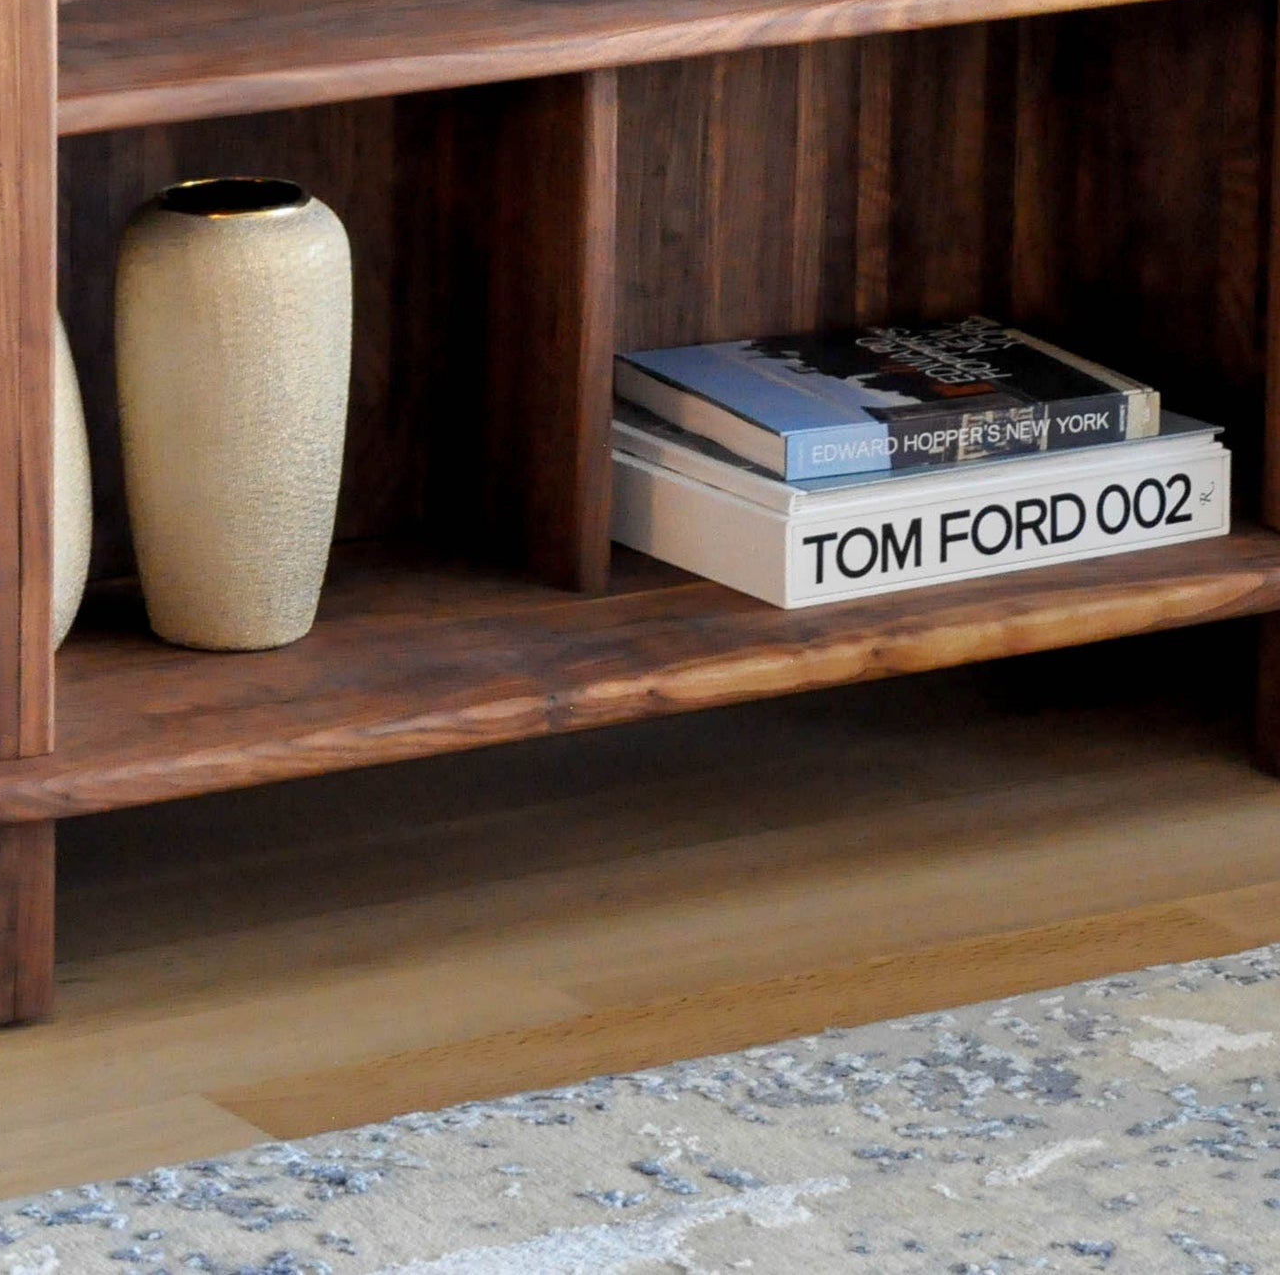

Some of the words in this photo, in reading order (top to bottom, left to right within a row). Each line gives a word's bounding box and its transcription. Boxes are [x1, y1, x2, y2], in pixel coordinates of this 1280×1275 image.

[812, 436, 898, 464] EDWARD
[904, 423, 1001, 454] HOPPER'S
[1006, 418, 1051, 440] NEW
[1056, 411, 1110, 435] YORK
[802, 517, 922, 585] TOM
[939, 492, 1087, 564] FORD
[1096, 473, 1193, 535] 002
